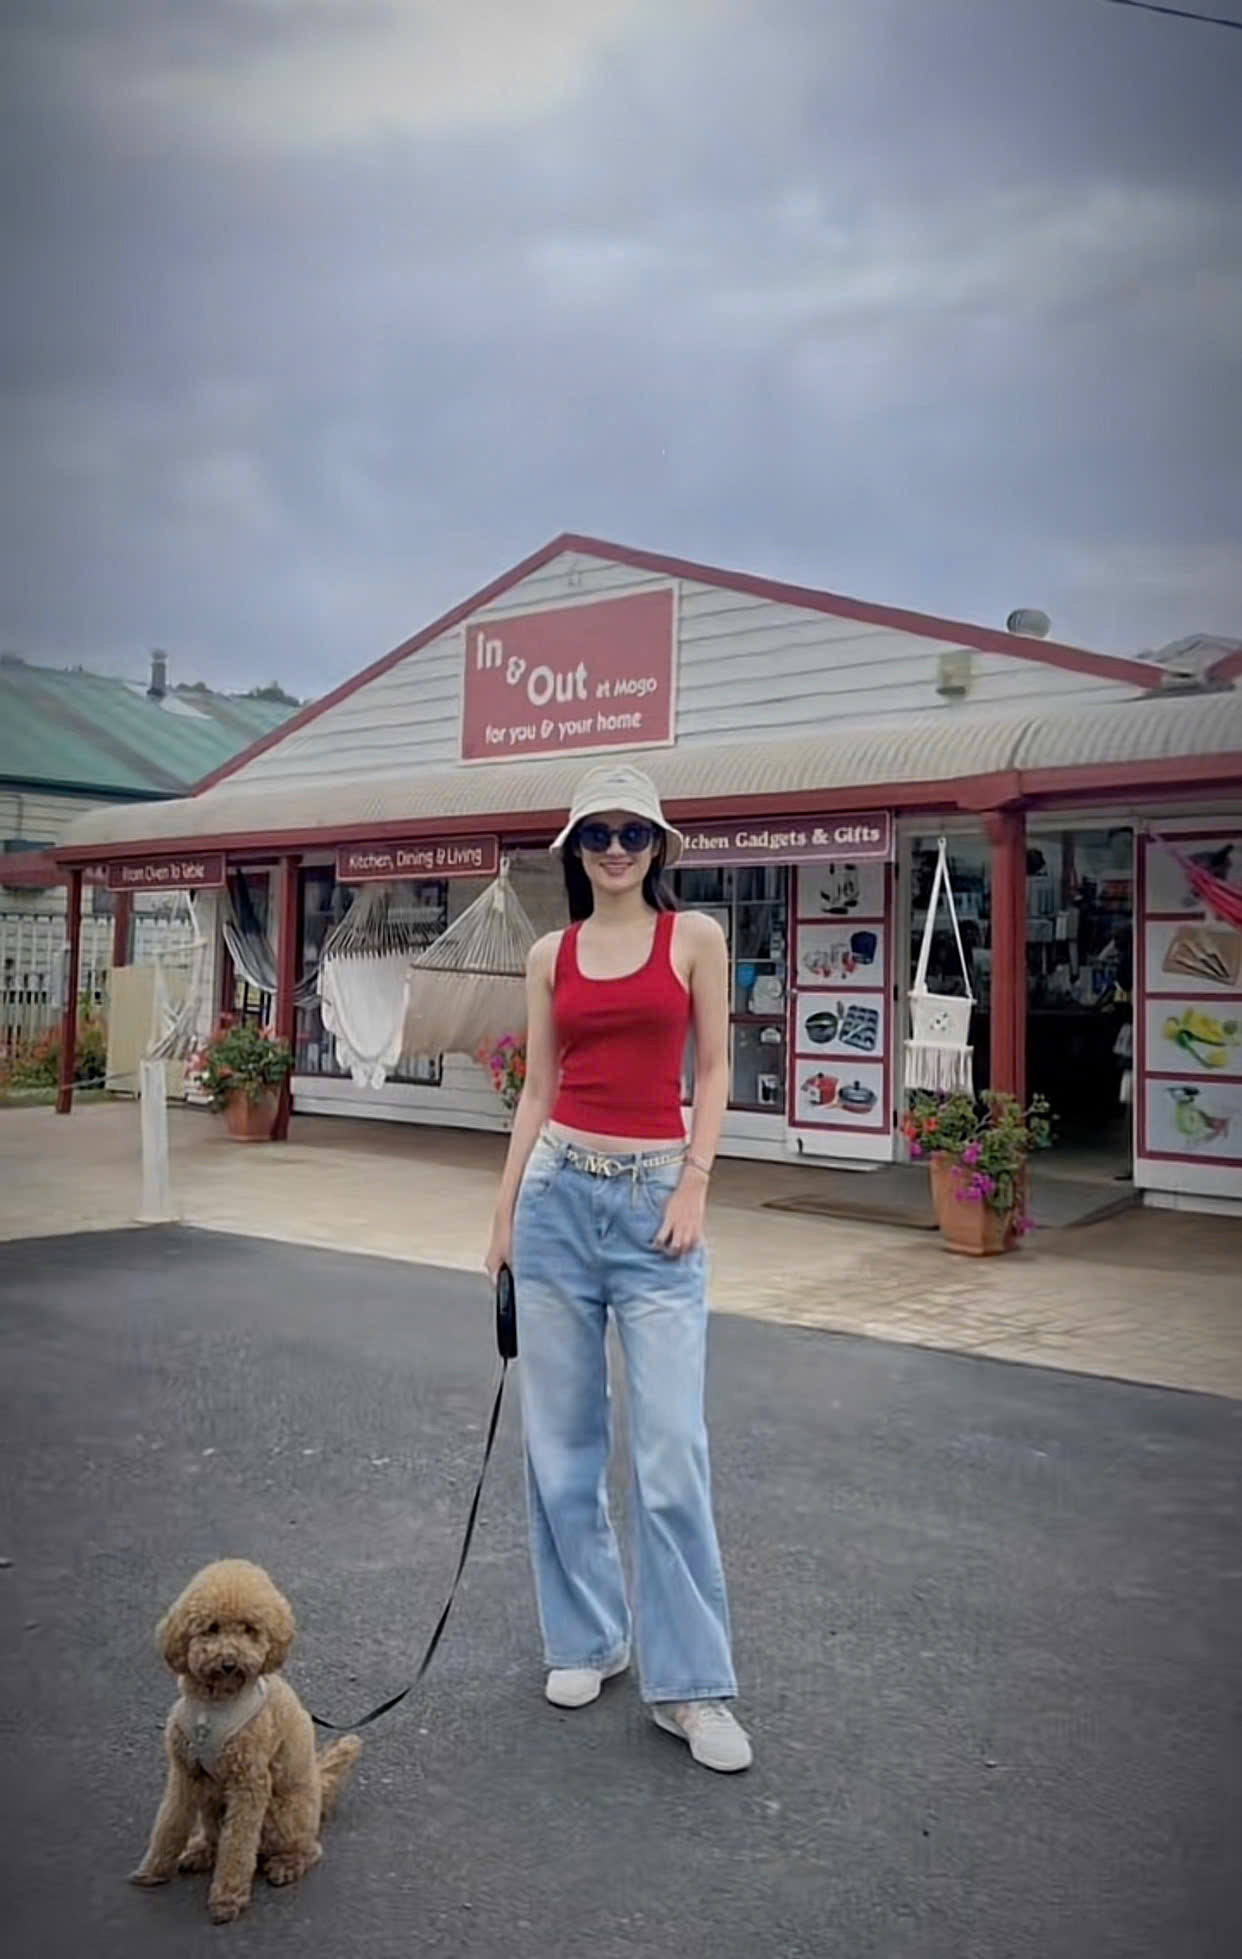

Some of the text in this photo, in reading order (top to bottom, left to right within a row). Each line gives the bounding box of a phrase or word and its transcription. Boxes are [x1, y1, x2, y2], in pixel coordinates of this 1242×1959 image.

[476, 631, 658, 706] In & Out at Mogo
[485, 711, 643, 745] for you & your home
[683, 826, 880, 850] tchen Gadgets & Gifts
[397, 850, 434, 869] Dining
[436, 847, 446, 864] &
[447, 847, 482, 866] Living
